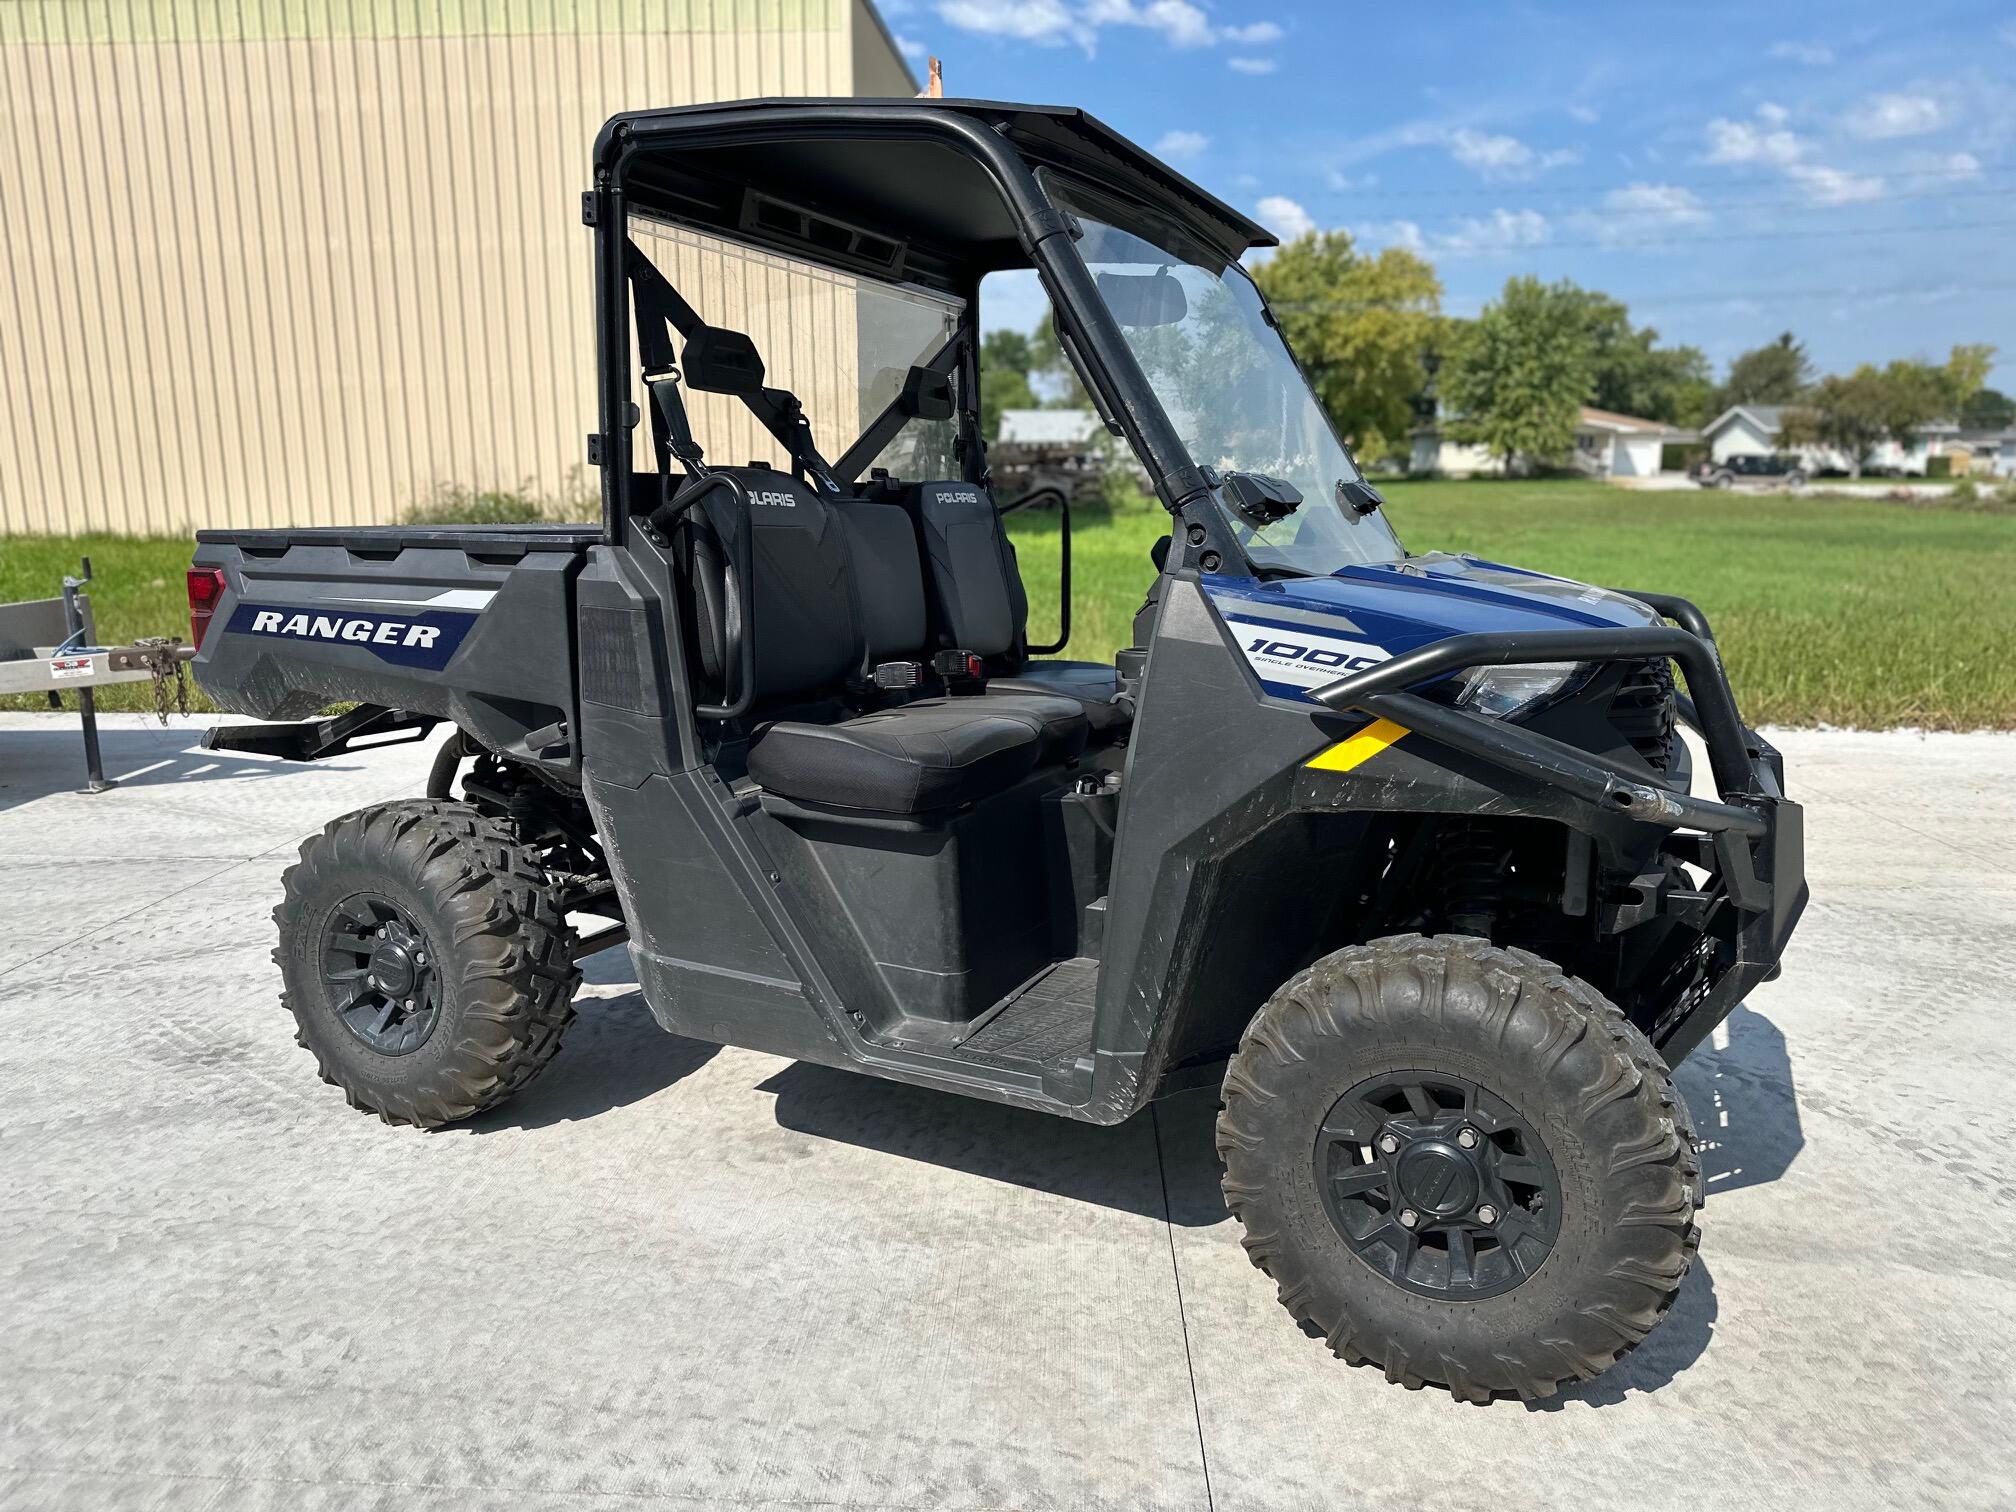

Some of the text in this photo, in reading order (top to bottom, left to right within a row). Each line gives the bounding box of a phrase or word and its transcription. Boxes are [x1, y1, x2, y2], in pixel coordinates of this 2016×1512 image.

[746, 491, 796, 507] OLARIS
[936, 492, 978, 504] POLARIS
[251, 611, 441, 648] RANGER
[1254, 657, 1293, 667] SINGLE
